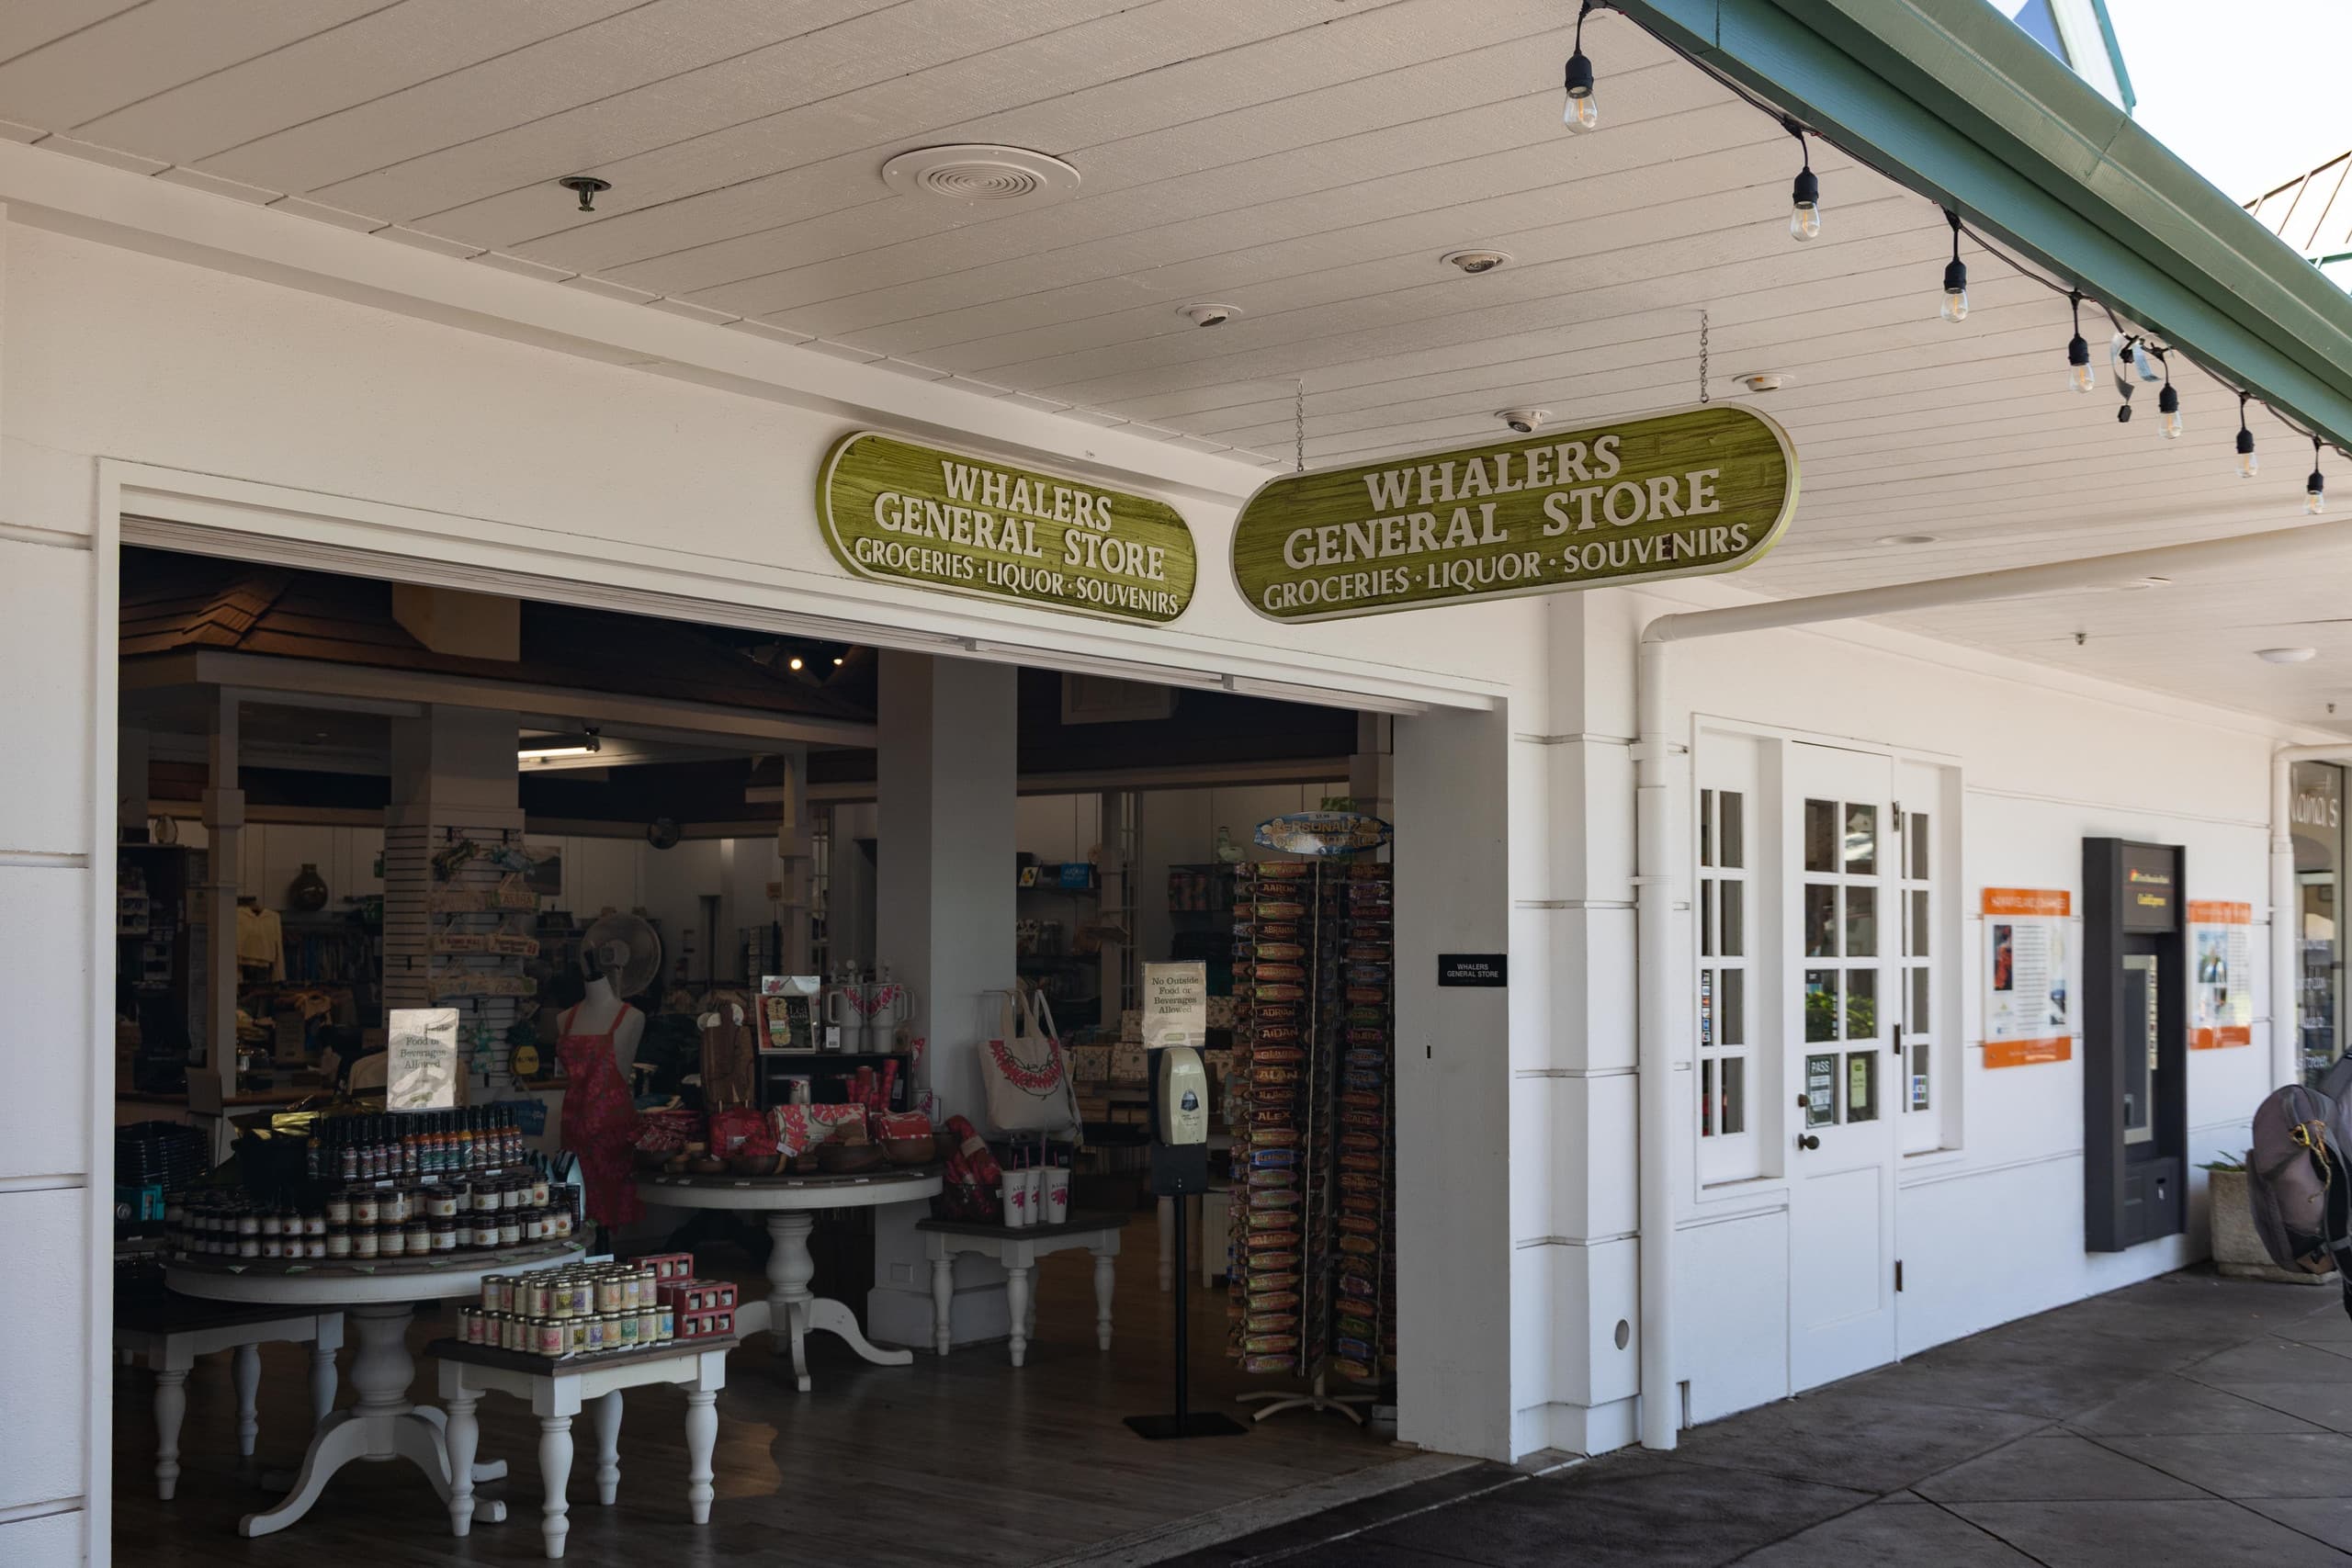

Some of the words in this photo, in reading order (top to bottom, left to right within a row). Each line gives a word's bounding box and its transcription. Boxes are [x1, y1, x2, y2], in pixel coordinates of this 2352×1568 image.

[1364, 435, 1622, 513] WHALERS
[941, 460, 1113, 532] WHALERS
[1283, 502, 1509, 570] GENERAL
[1543, 468, 1721, 536] STORE
[874, 491, 1043, 558] GENERAL
[1064, 527, 1165, 581] STORE
[1262, 568, 1409, 611] GROCERIES
[1428, 550, 1542, 592] LIQUOR
[1563, 523, 1749, 574] SOUVENIRS
[854, 537, 974, 580] GROCERIES
[987, 561, 1064, 597] LIQUOR
[1077, 577, 1179, 616] SOUVENIRS
[1263, 883, 1296, 893] AARON
[1151, 977, 1165, 986] No
[1166, 976, 1199, 986] Outside
[1159, 987, 1180, 995] Food
[1154, 997, 1197, 1006] Beverages
[1159, 1006, 1193, 1014] Allowed
[406, 1036, 428, 1046] Food
[400, 1049, 447, 1059] Beverages
[404, 1060, 441, 1069] Allowed
[1811, 1060, 1830, 1074] PASS
[1258, 1111, 1292, 1121] ALEX
